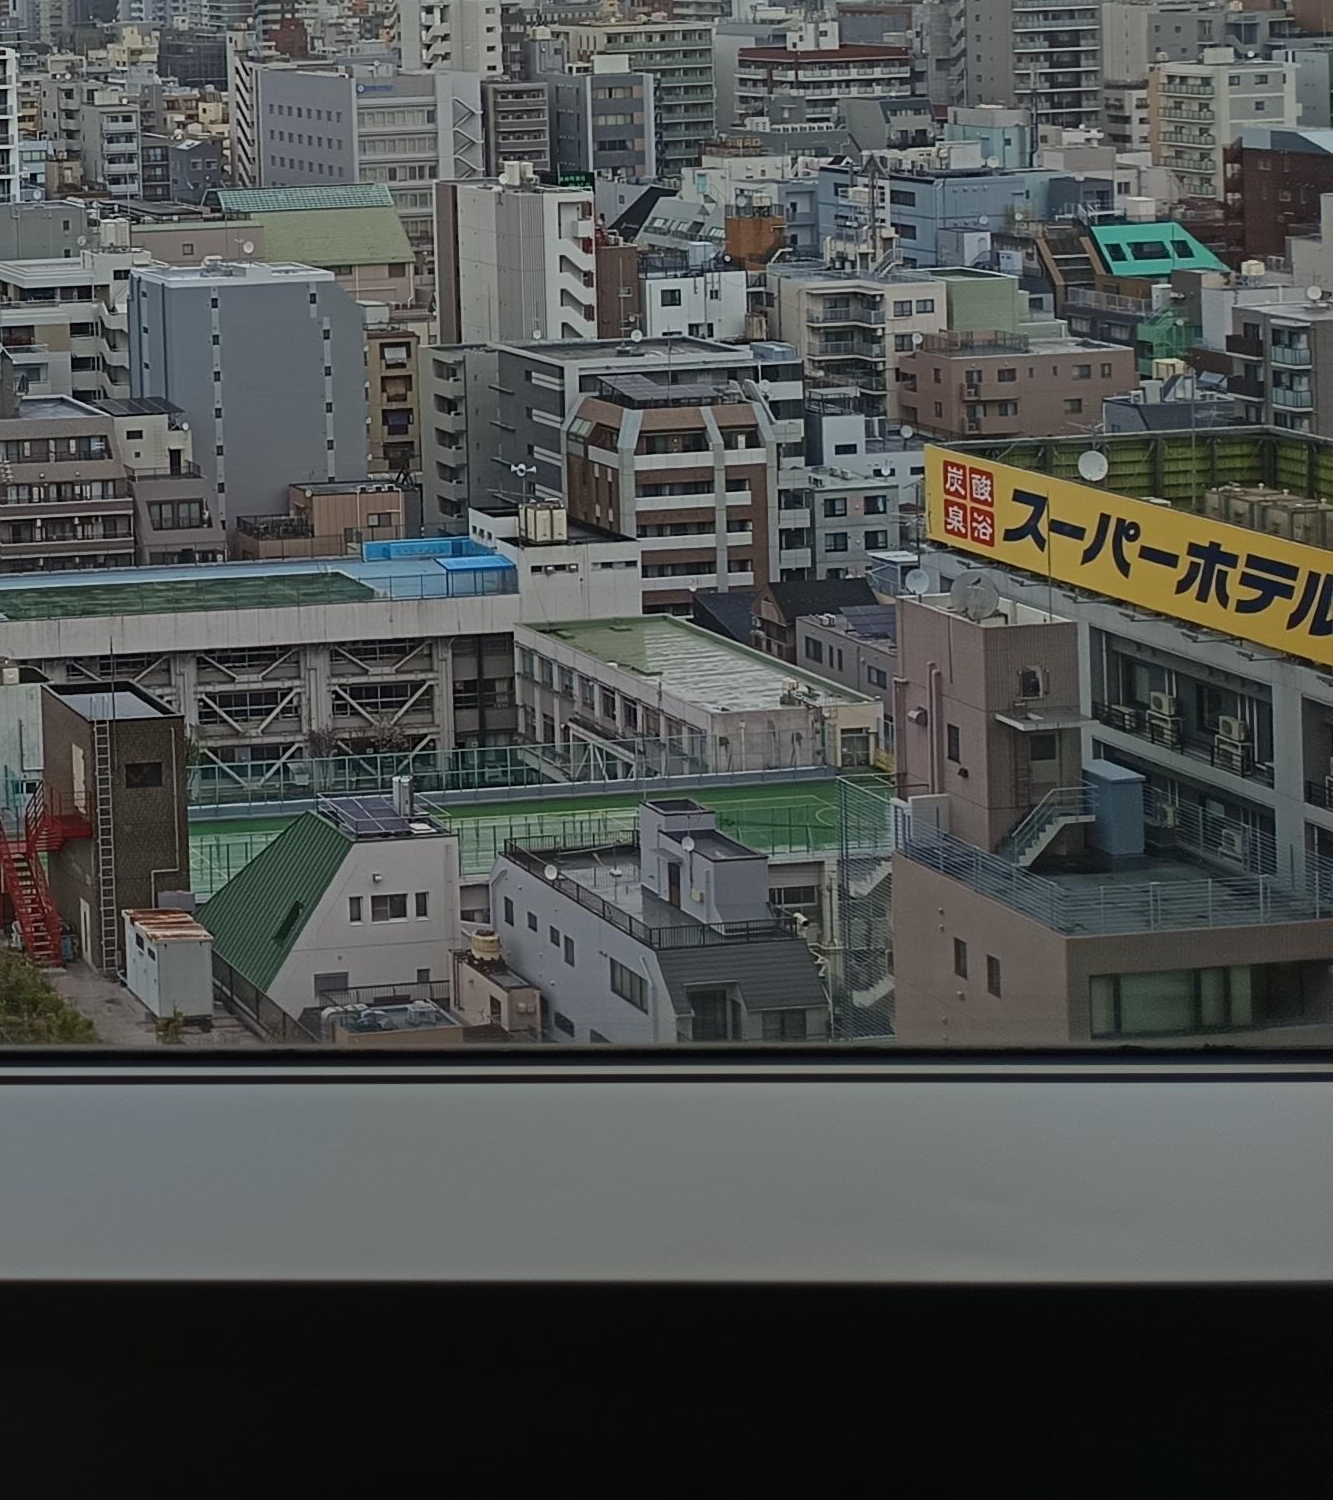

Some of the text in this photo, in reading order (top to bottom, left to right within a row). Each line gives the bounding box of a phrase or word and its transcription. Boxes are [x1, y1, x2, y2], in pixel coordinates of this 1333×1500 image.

[1001, 488, 1333, 636] スーパーホテル
